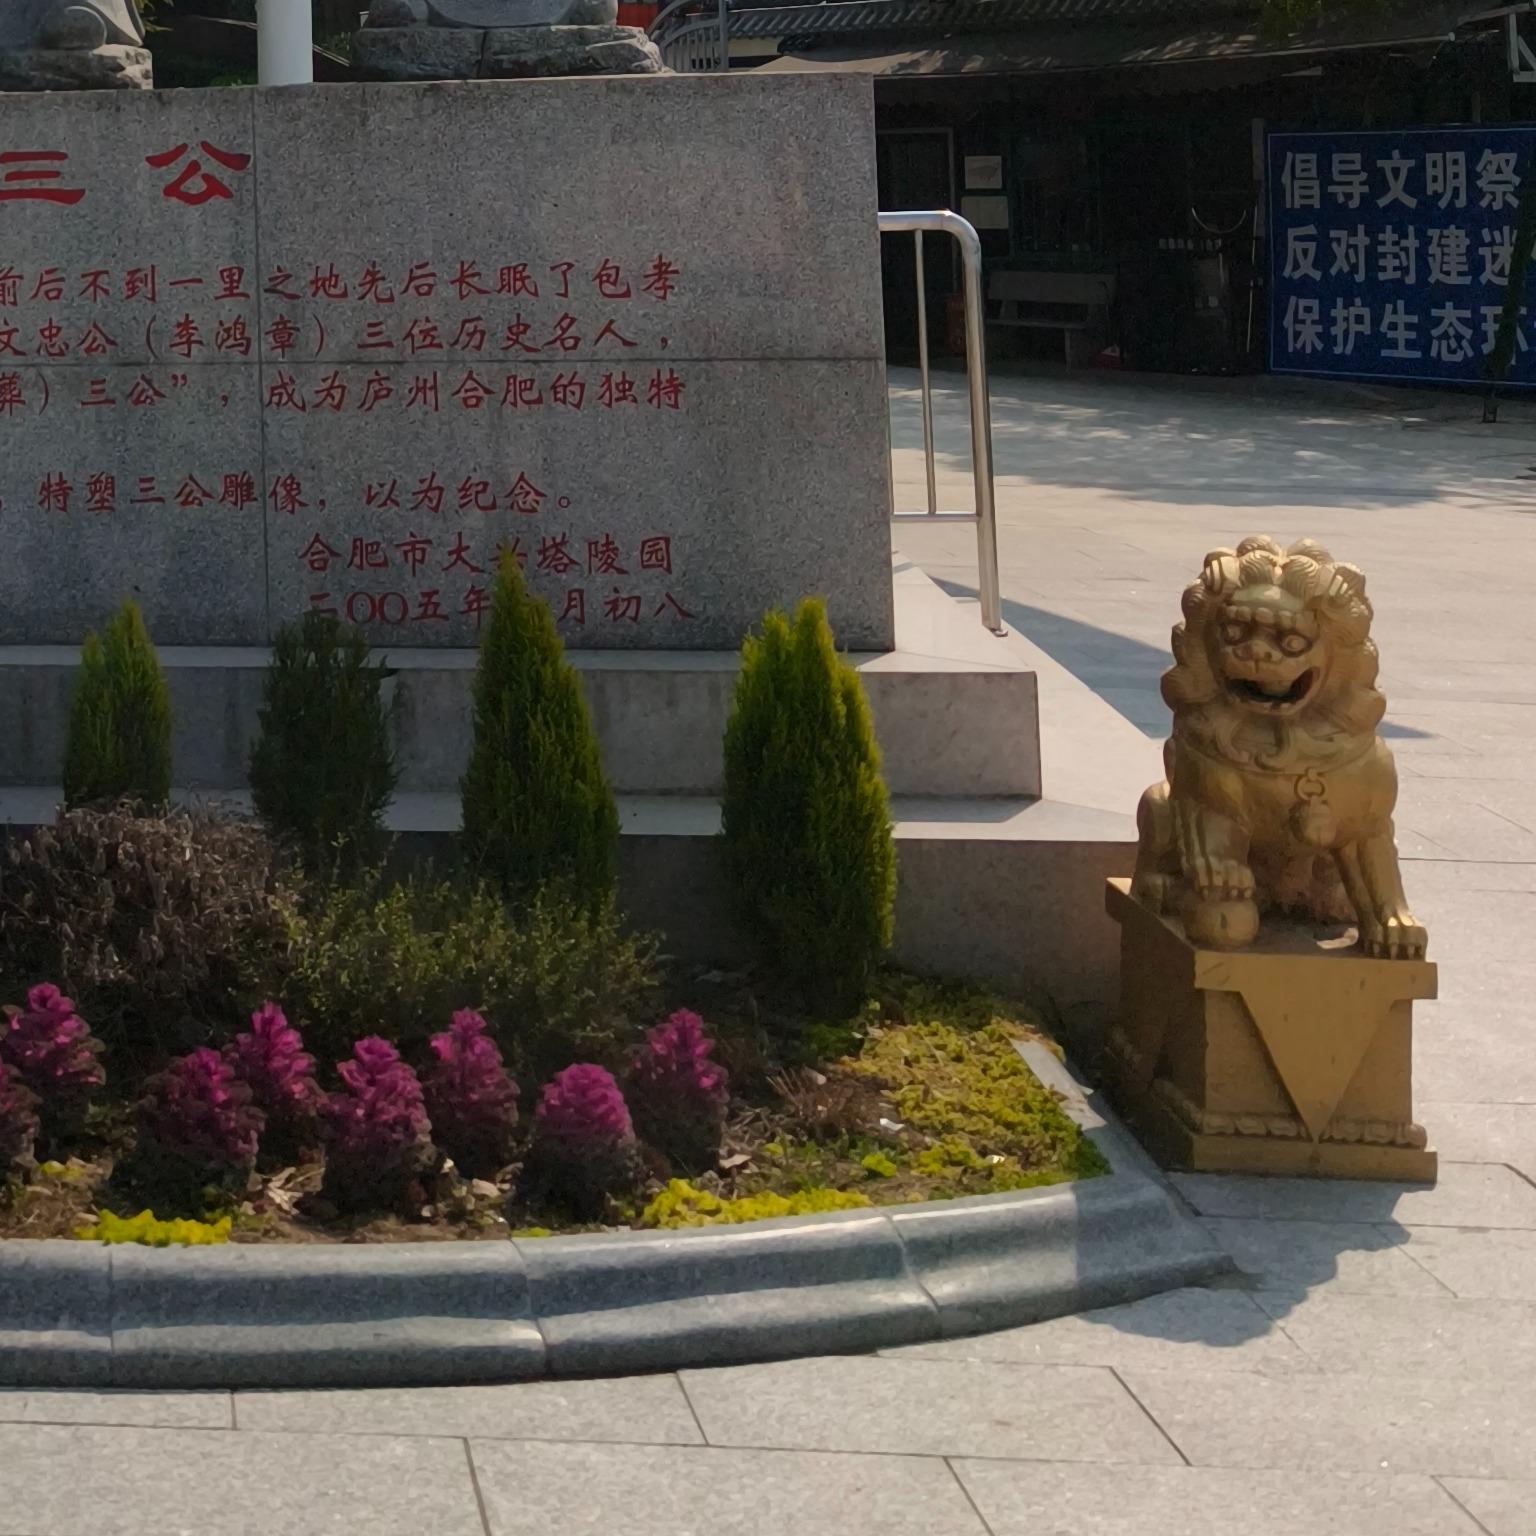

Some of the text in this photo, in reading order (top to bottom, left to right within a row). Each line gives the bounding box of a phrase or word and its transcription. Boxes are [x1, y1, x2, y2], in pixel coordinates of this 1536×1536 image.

[1282, 224, 1536, 286] 反对封建迷
